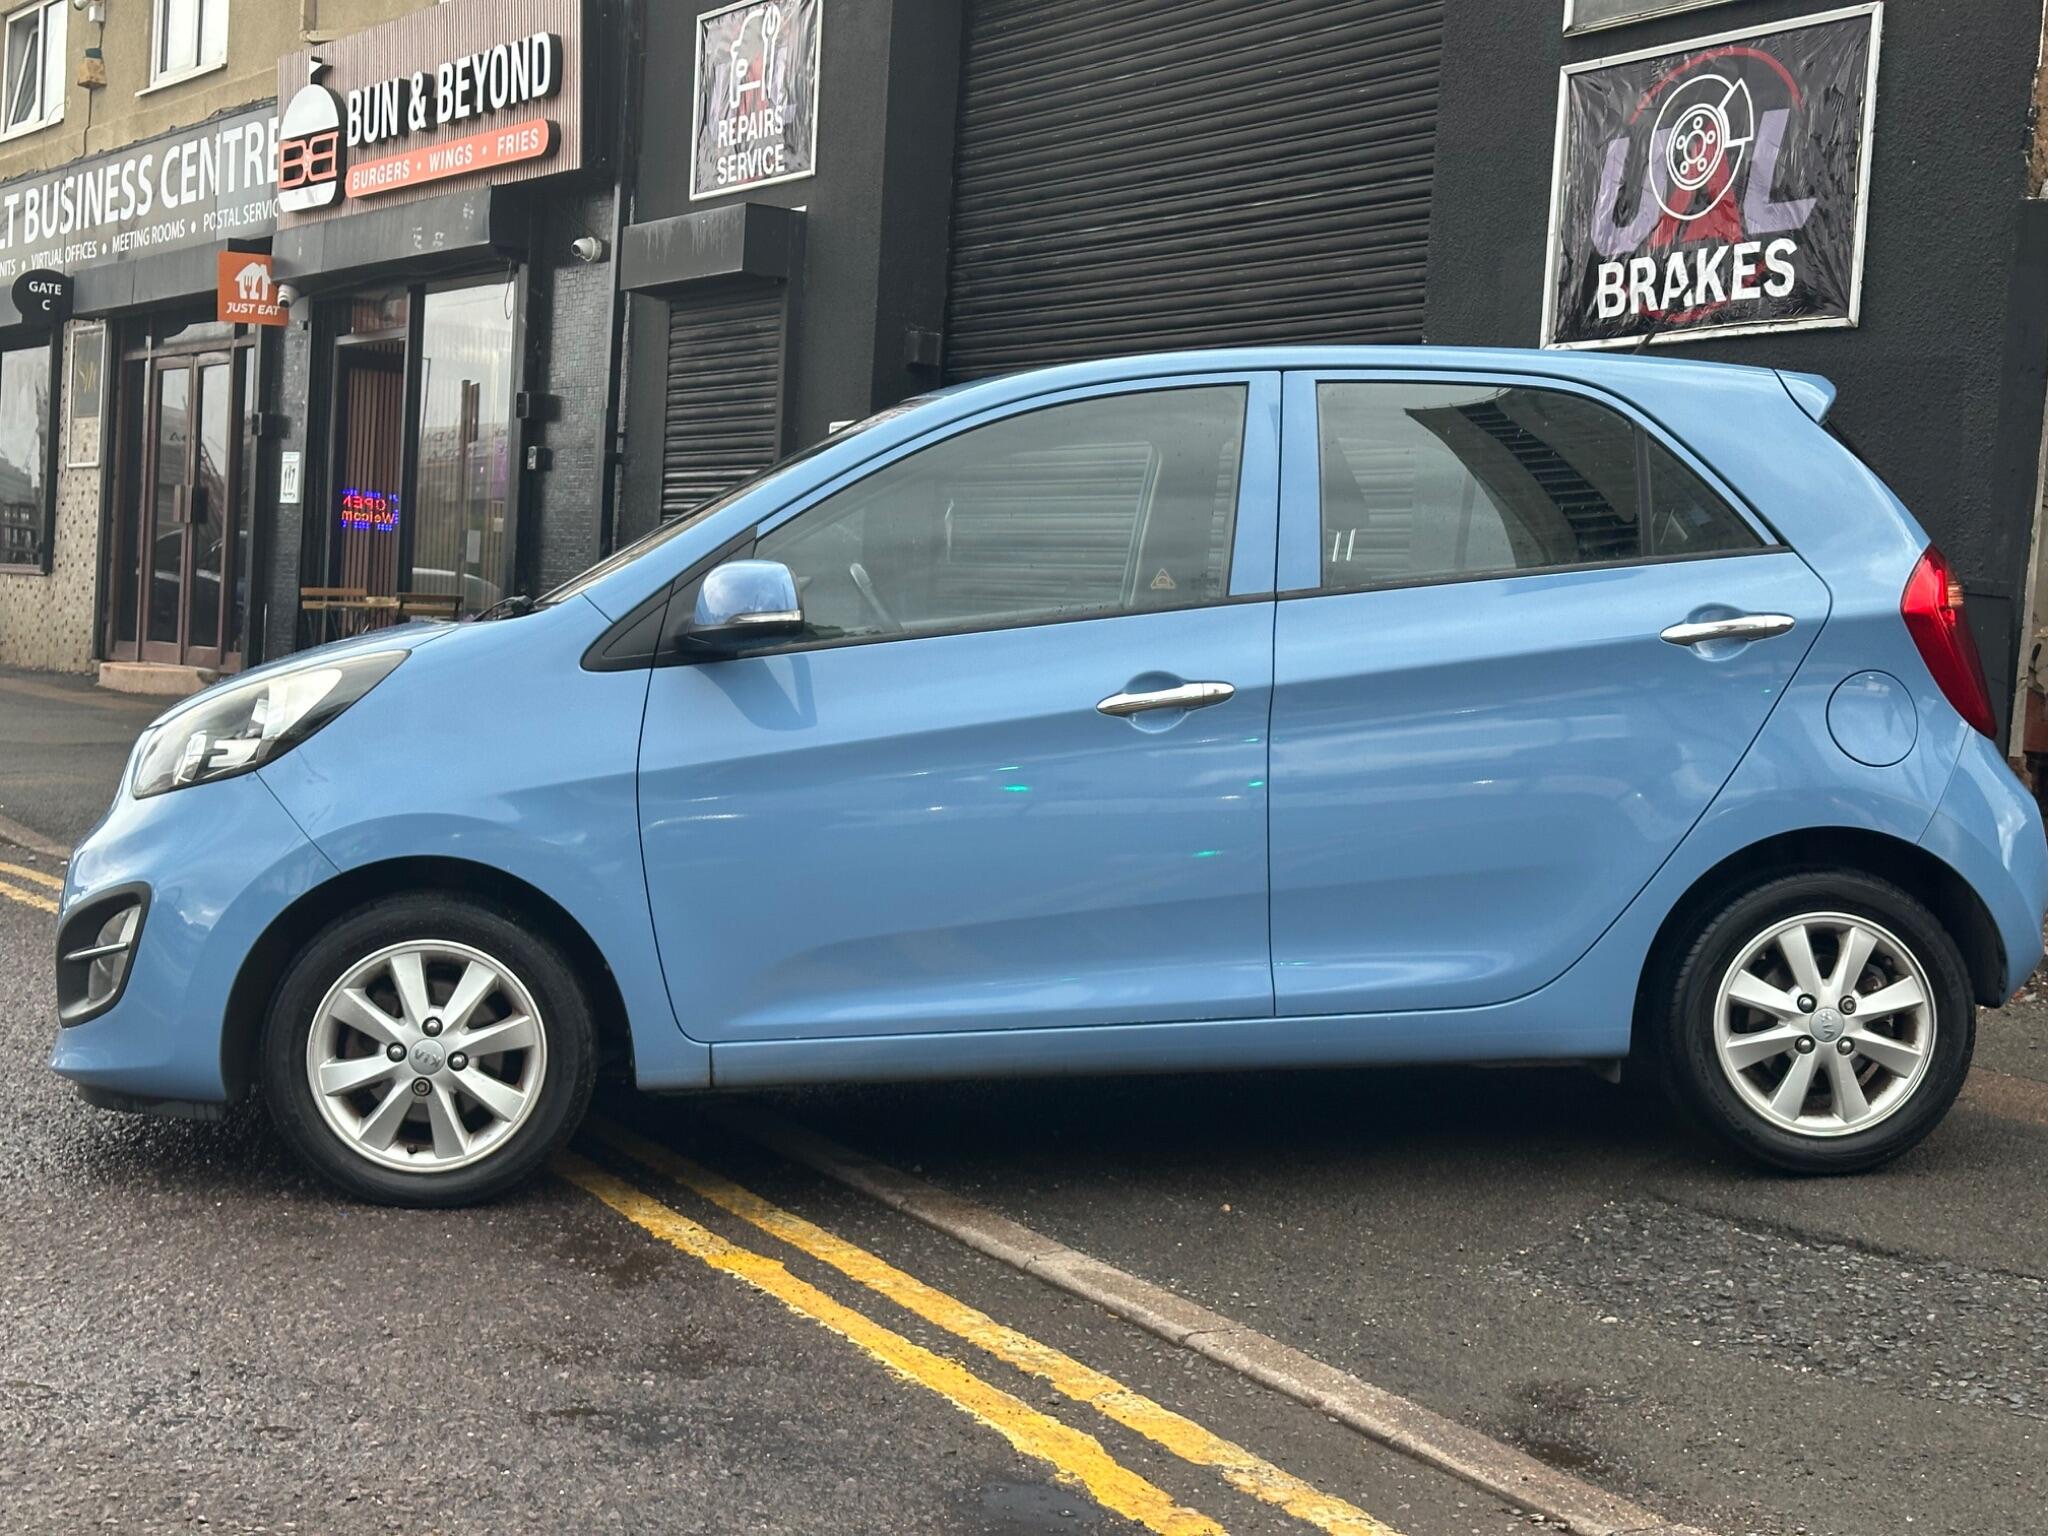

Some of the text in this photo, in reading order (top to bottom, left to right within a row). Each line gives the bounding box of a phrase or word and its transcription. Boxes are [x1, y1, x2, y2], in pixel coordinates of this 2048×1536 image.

[347, 31, 550, 147] BUN & BEYOND
[717, 105, 784, 148] REPAIRS
[352, 128, 540, 190] BURGERS WINGS FRIES
[716, 144, 785, 185] SERVICE
[24, 154, 153, 245] BUSINESS
[31, 248, 63, 270] VIRTUAL
[65, 240, 97, 264] OFFICES
[112, 226, 149, 254] MEETING
[152, 218, 185, 244] ROOMS
[203, 207, 240, 233] POSTAL
[28, 280, 62, 296] GATE
[1598, 238, 1797, 318] BRAKES
[42, 299, 51, 311] C
[226, 302, 281, 316] JUST EAT
